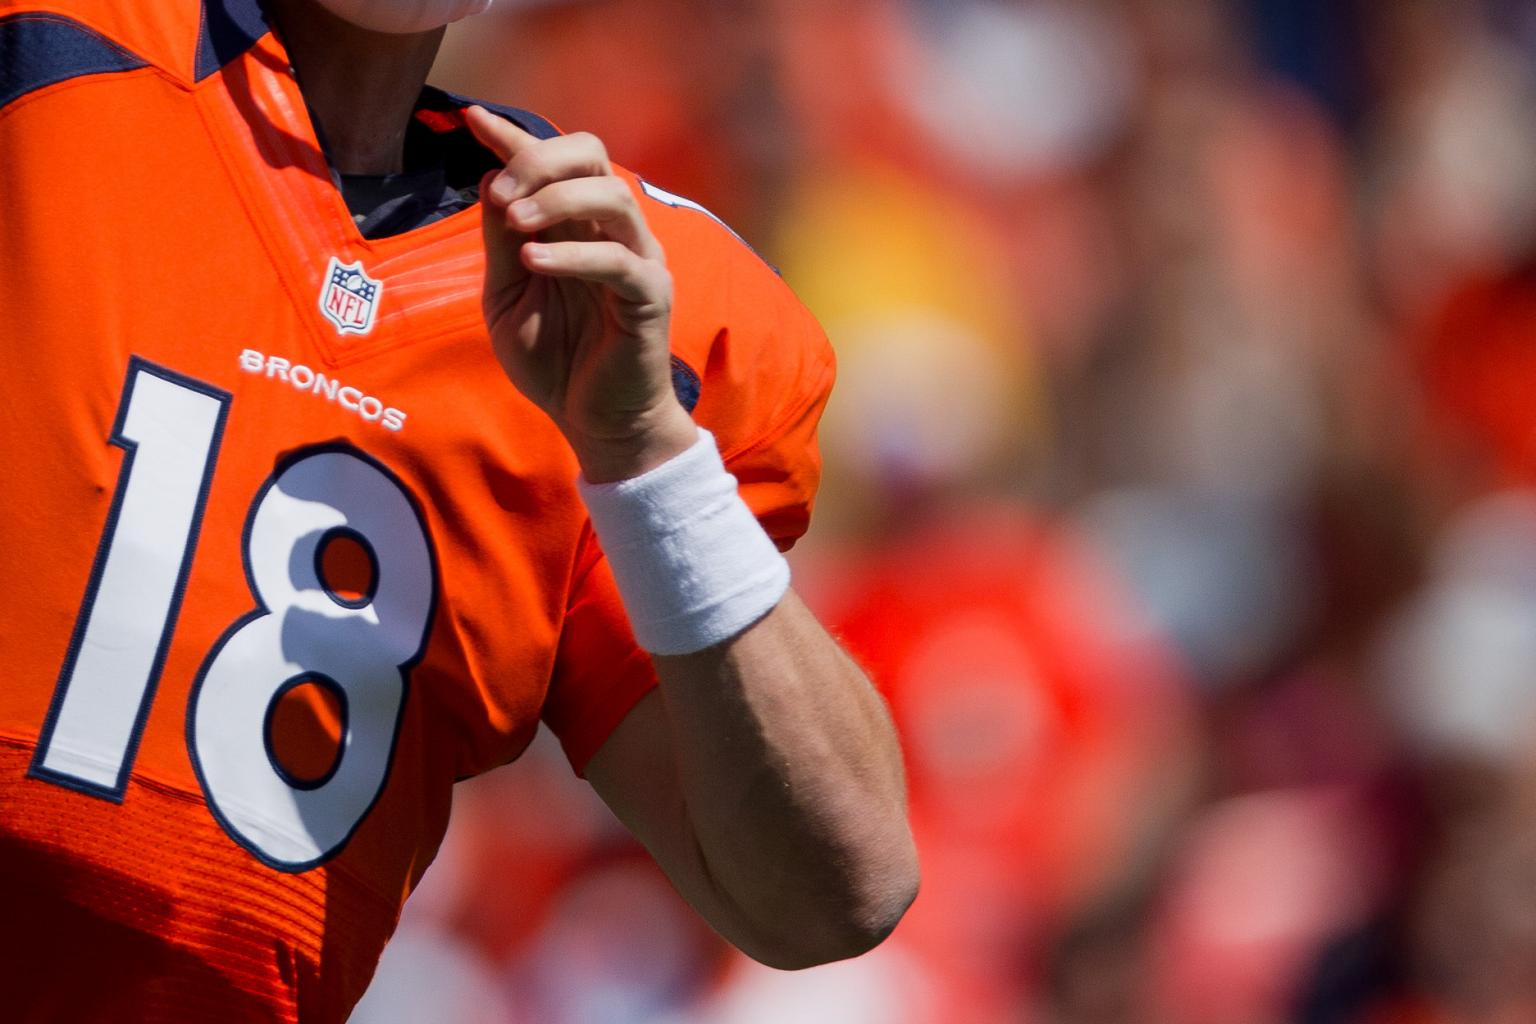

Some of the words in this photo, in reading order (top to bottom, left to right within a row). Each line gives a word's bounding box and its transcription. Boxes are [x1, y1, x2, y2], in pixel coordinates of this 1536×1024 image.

[327, 286, 366, 325] NFL
[238, 347, 408, 433] BRONCOS
[25, 353, 438, 874] 18
